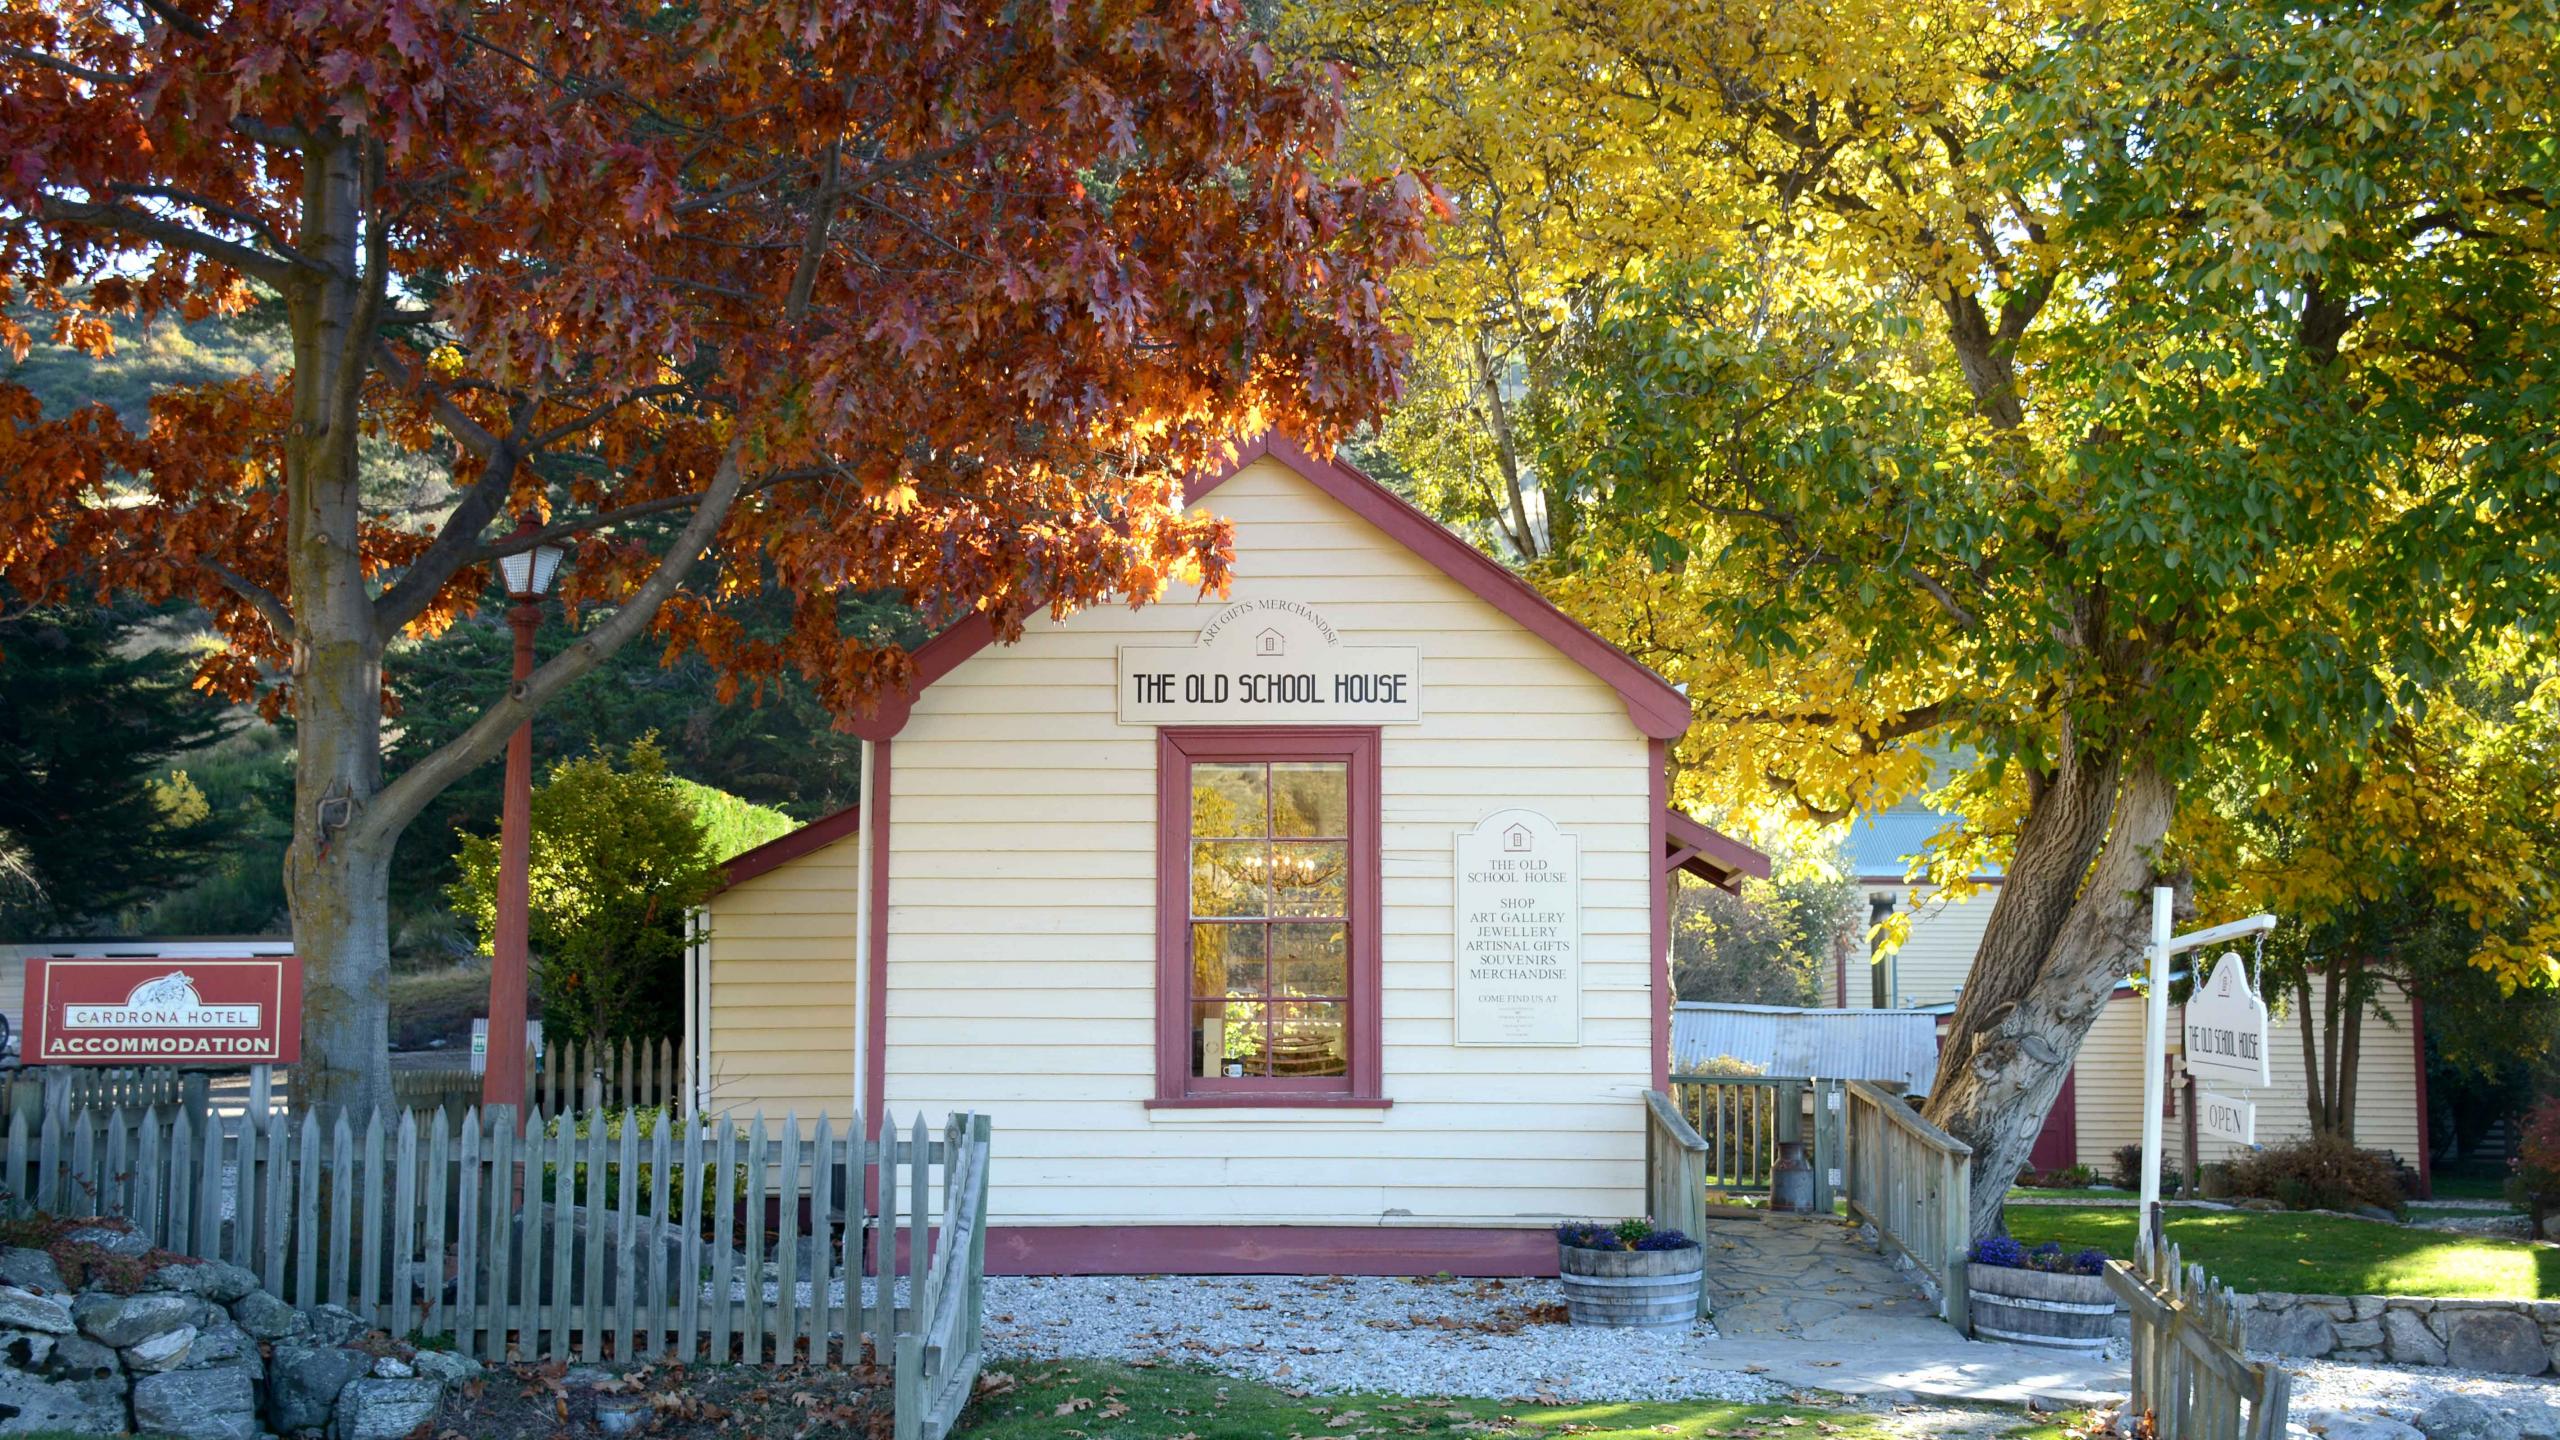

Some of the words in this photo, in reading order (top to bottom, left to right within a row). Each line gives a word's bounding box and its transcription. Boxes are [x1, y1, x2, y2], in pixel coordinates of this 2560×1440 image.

[1203, 621, 1221, 647] ART
[1220, 601, 1253, 625] GIFTS
[1258, 599, 1339, 647] MERCHANDISE
[1133, 673, 1175, 704] THE
[1185, 673, 1229, 704] OLD
[1239, 673, 1325, 704] SCHOOL
[1335, 673, 1407, 704] HOUSE
[1489, 859, 1515, 871] THE
[1519, 859, 1548, 871] OLD
[1467, 872, 1519, 883] SCHOOL
[1524, 872, 1567, 883] HOUSE
[1500, 898, 1535, 909] SHOP
[1470, 912, 1497, 923] ART
[1501, 912, 1566, 923] GALLERY
[1477, 926, 1557, 937] JEWELLERY
[1466, 940, 1530, 951] ARTISNAL
[1533, 940, 1570, 951] GIFTS
[1480, 954, 1557, 965] SOUVENIRS
[1470, 968, 1567, 980] MERCHANDISE
[1478, 994, 1505, 1003] COME
[1507, 994, 1530, 1003] FIND
[1531, 994, 1544, 1003] US
[1546, 994, 1558, 1003] AT
[76, 1011, 179, 1024] CARDRONA
[188, 1011, 249, 1024] HOTEL
[50, 1037, 270, 1053] ACCOMMODATION
[2189, 1025, 2199, 1052] THE
[2200, 1027, 2213, 1054] OLD
[2214, 1029, 2237, 1057] SCHOOL
[2238, 1031, 2259, 1061] HOUSE
[2209, 1104, 2242, 1134] OPEN
